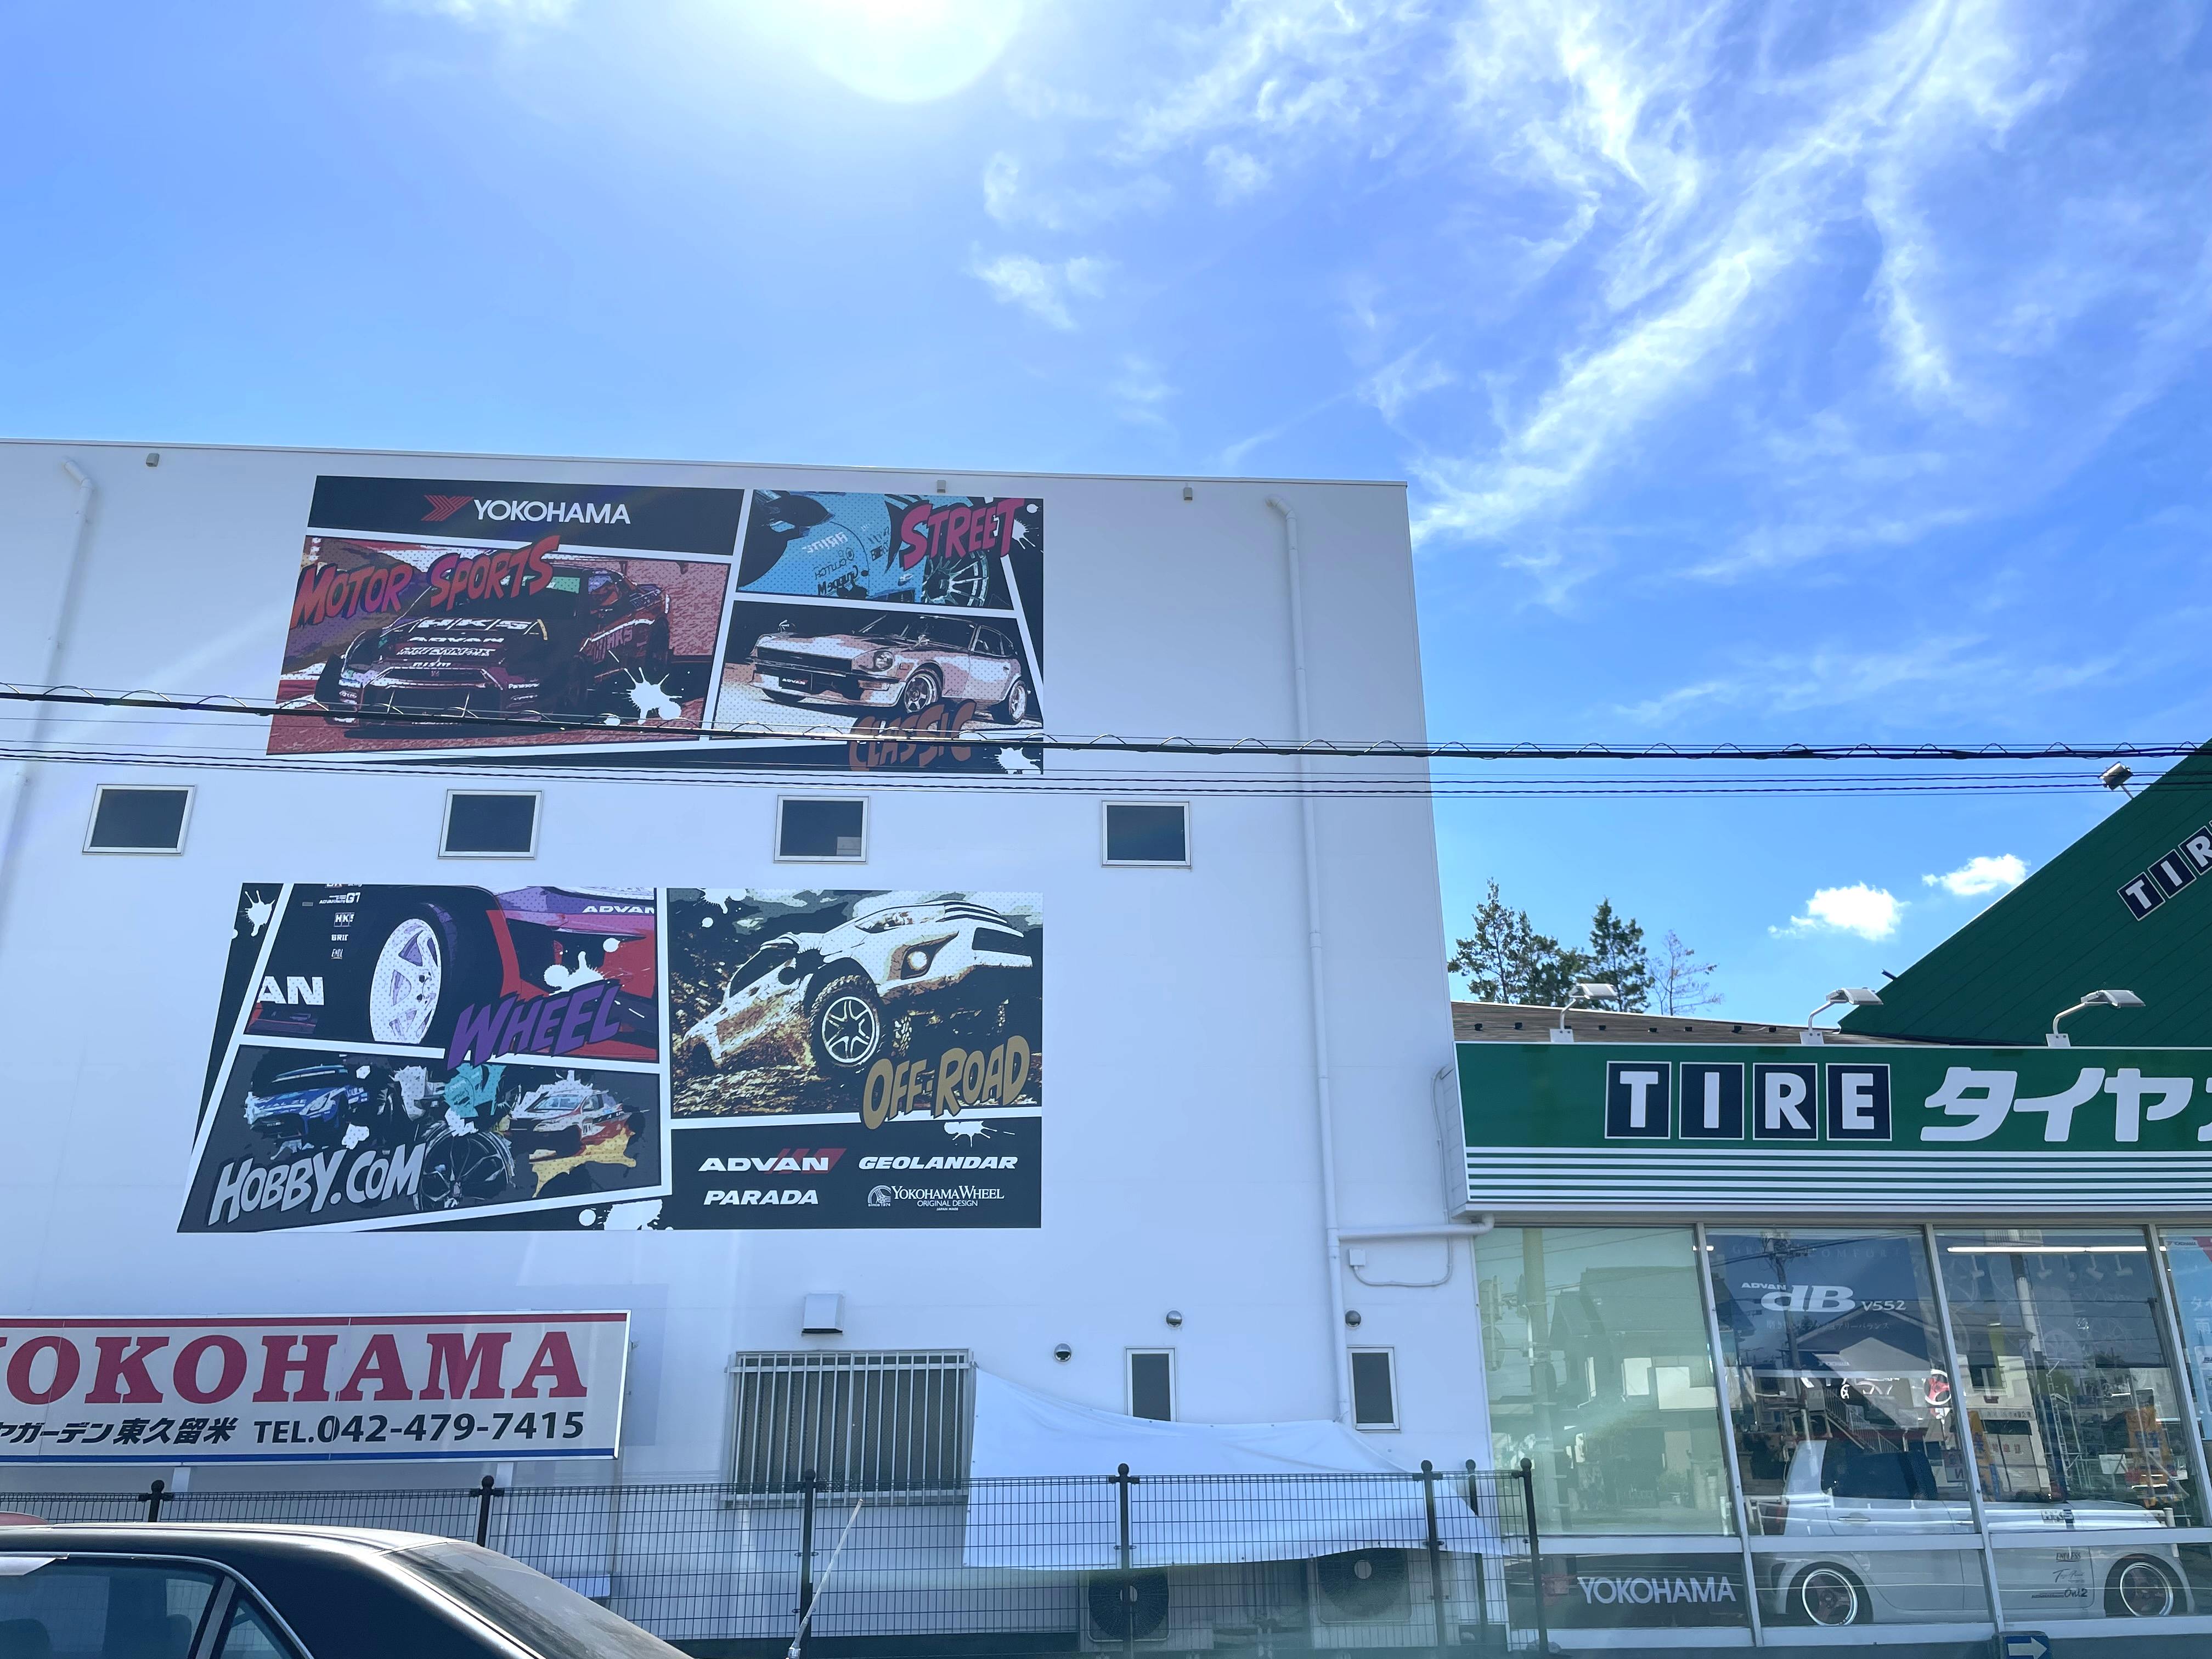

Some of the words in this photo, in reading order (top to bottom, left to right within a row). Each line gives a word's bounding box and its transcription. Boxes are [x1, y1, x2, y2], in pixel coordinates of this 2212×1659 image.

[473, 499, 631, 525] YOKOHAMA
[900, 498, 1025, 571] STREET
[291, 560, 414, 629] MOTOR
[427, 535, 560, 611] SPORTS
[848, 699, 977, 771] CLASSIC
[582, 905, 655, 914] ADVAN
[257, 975, 325, 1006] AN
[447, 980, 620, 1070] WHEEL
[861, 1035, 1030, 1130] OFF-ROAD
[1618, 1070, 1875, 1130] TIRE
[1920, 1066, 2212, 1143] タイヤ
[698, 1157, 830, 1172] ADVAN
[859, 1156, 1018, 1170] GEOLANDAR
[208, 1143, 427, 1227] HOBBY.COM
[703, 1189, 819, 1206] PARADA
[891, 1186, 960, 1200] YOKOHAMA
[958, 1185, 1005, 1200] WHEEL
[1741, 1282, 1786, 1290] ADVAN
[1760, 1284, 1856, 1312] dB
[1861, 1300, 1906, 1311] V552
[0, 1331, 588, 1404] OKOHAMA
[253, 1410, 585, 1444] TEL.042-479-7415
[1577, 1576, 1737, 1605] YOKOHAMA
